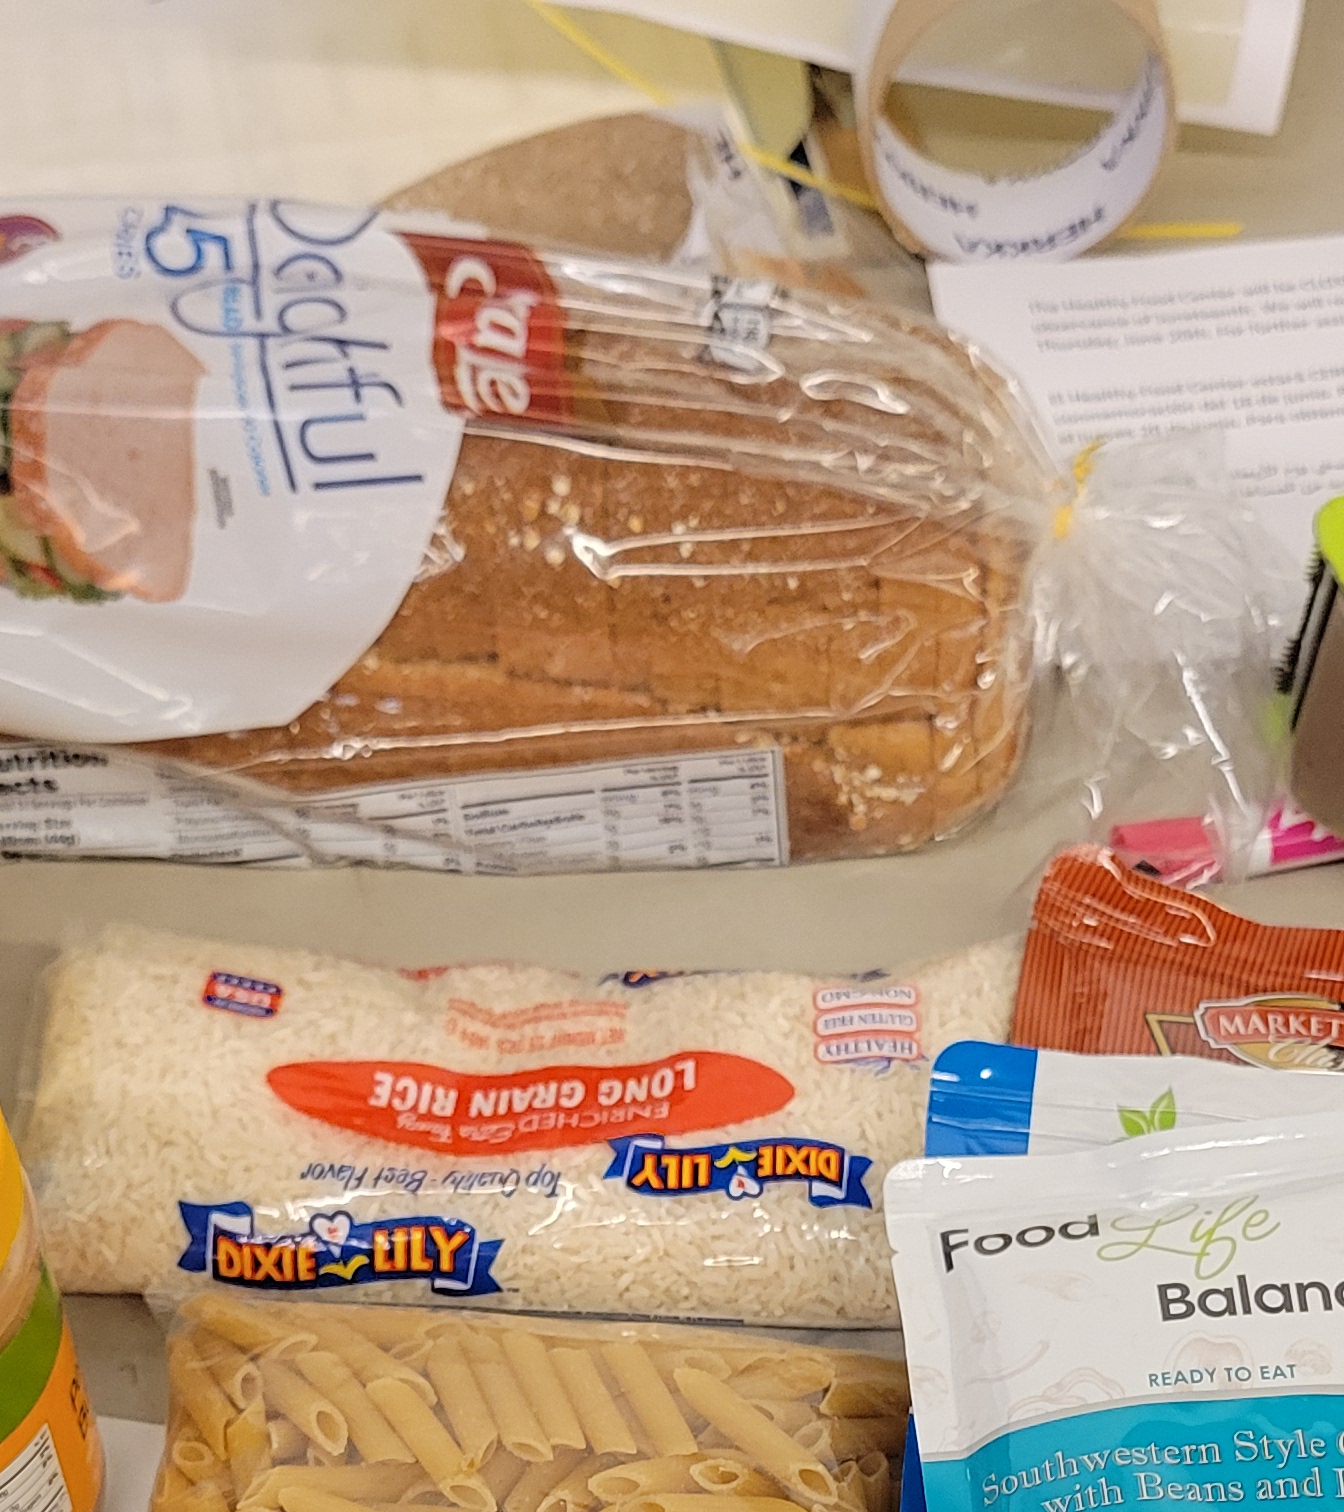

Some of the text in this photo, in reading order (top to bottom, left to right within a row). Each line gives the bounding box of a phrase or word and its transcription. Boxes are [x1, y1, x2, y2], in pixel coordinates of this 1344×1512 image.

[856, 1012, 914, 1027] GLUTEN
[823, 1039, 914, 1059] HEALTHY
[369, 1059, 697, 1116] LONG GRAIN RICE
[514, 1104, 671, 1134] ENRICHED
[373, 1164, 428, 1193] Best
[631, 1146, 841, 1190] DIXIE LILY
[216, 1226, 471, 1282] DIXIE LILY
[940, 1195, 1281, 1281] Food Life
[1148, 1362, 1297, 1389] READY TO EAT
[981, 1440, 1223, 1507] Southwestern
[1234, 1429, 1329, 1472] Style
[1136, 1470, 1246, 1503] Beans
[1255, 1465, 1325, 1501] and
